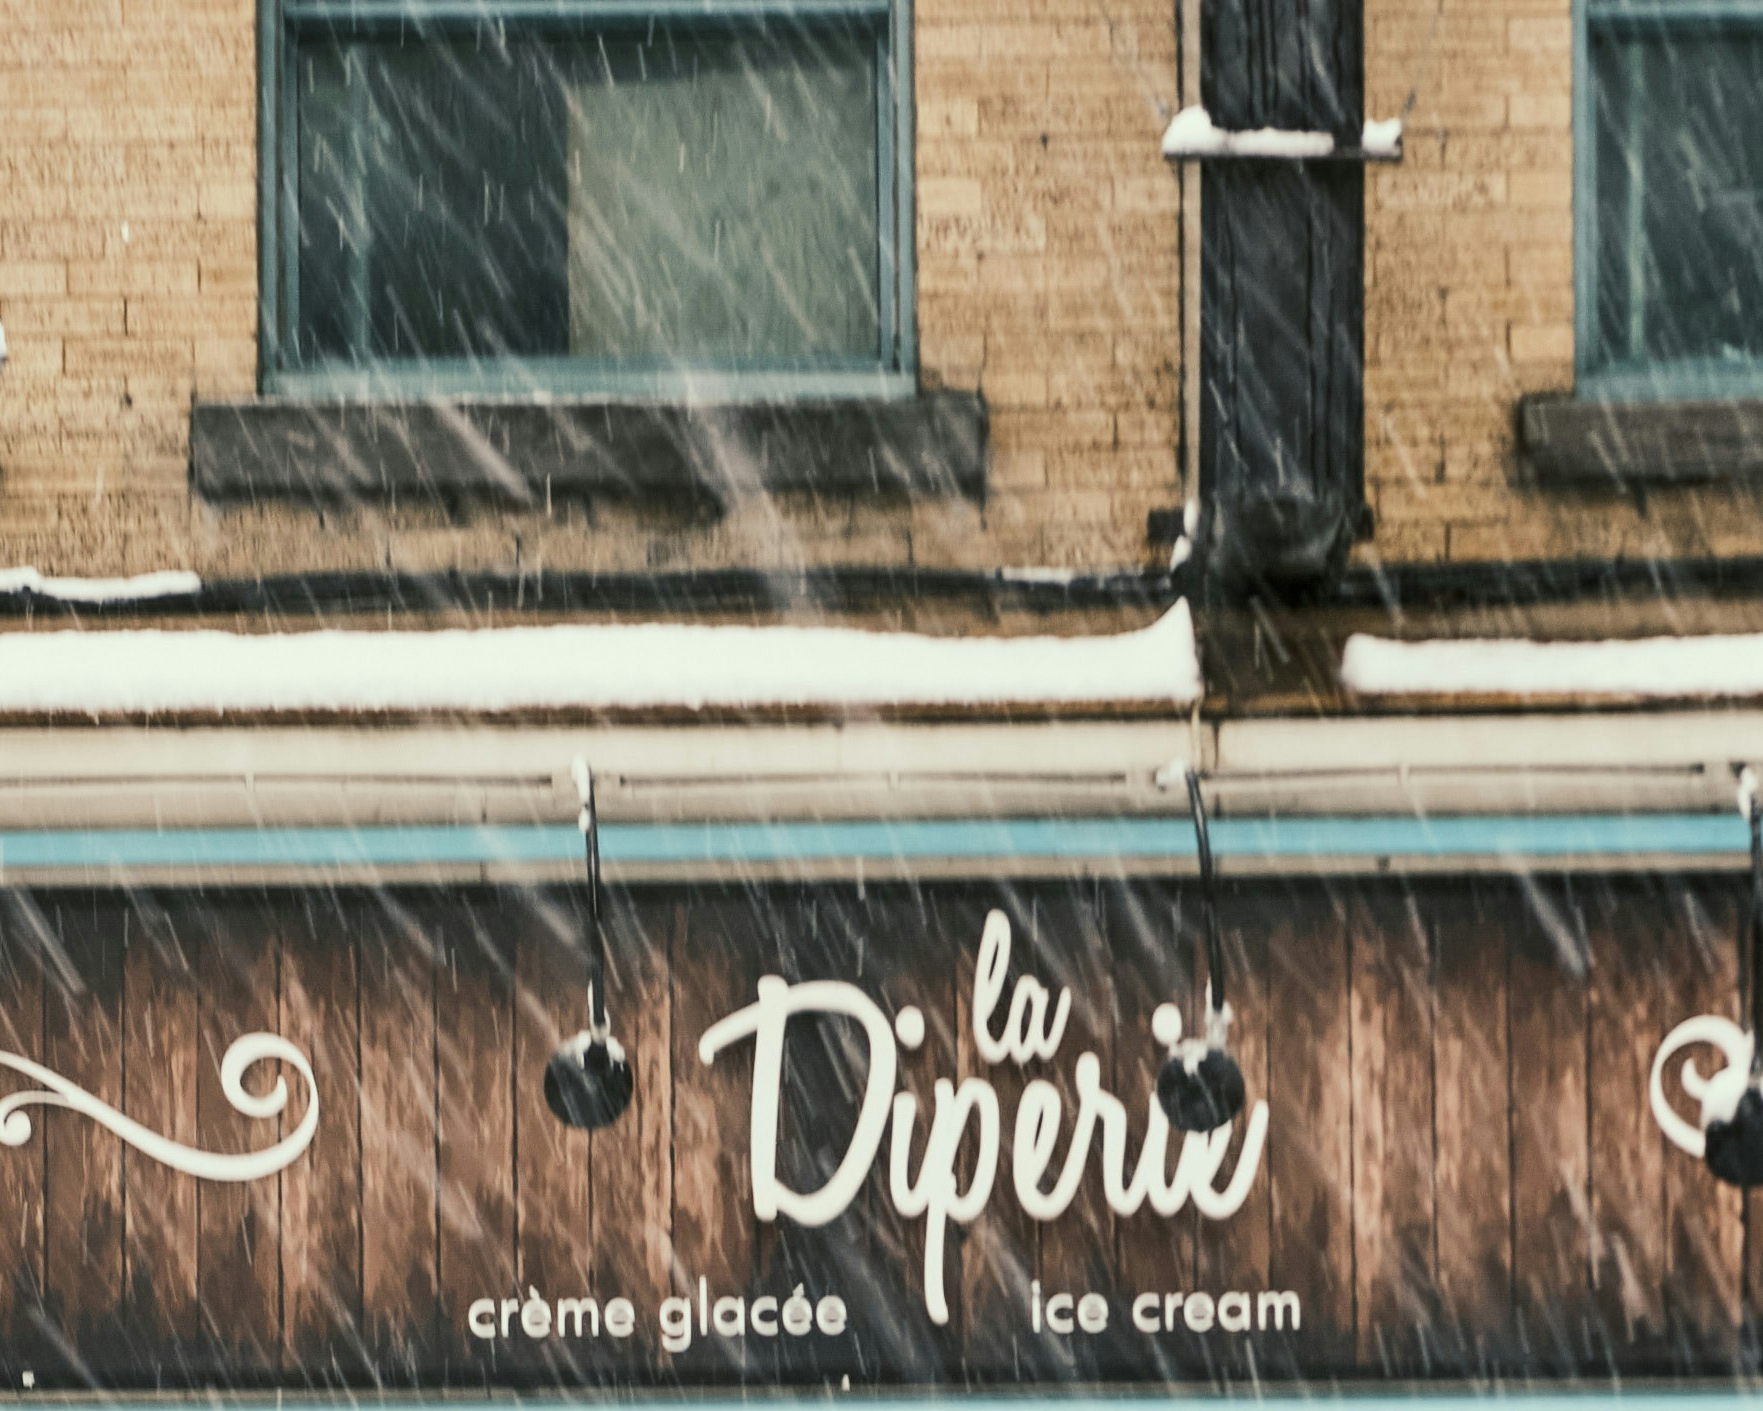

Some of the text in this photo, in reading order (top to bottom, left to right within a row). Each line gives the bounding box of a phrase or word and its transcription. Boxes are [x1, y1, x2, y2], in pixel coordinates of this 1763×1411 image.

[972, 908, 1071, 1065] la
[467, 1274, 1301, 1353] crème glacée ice cream
